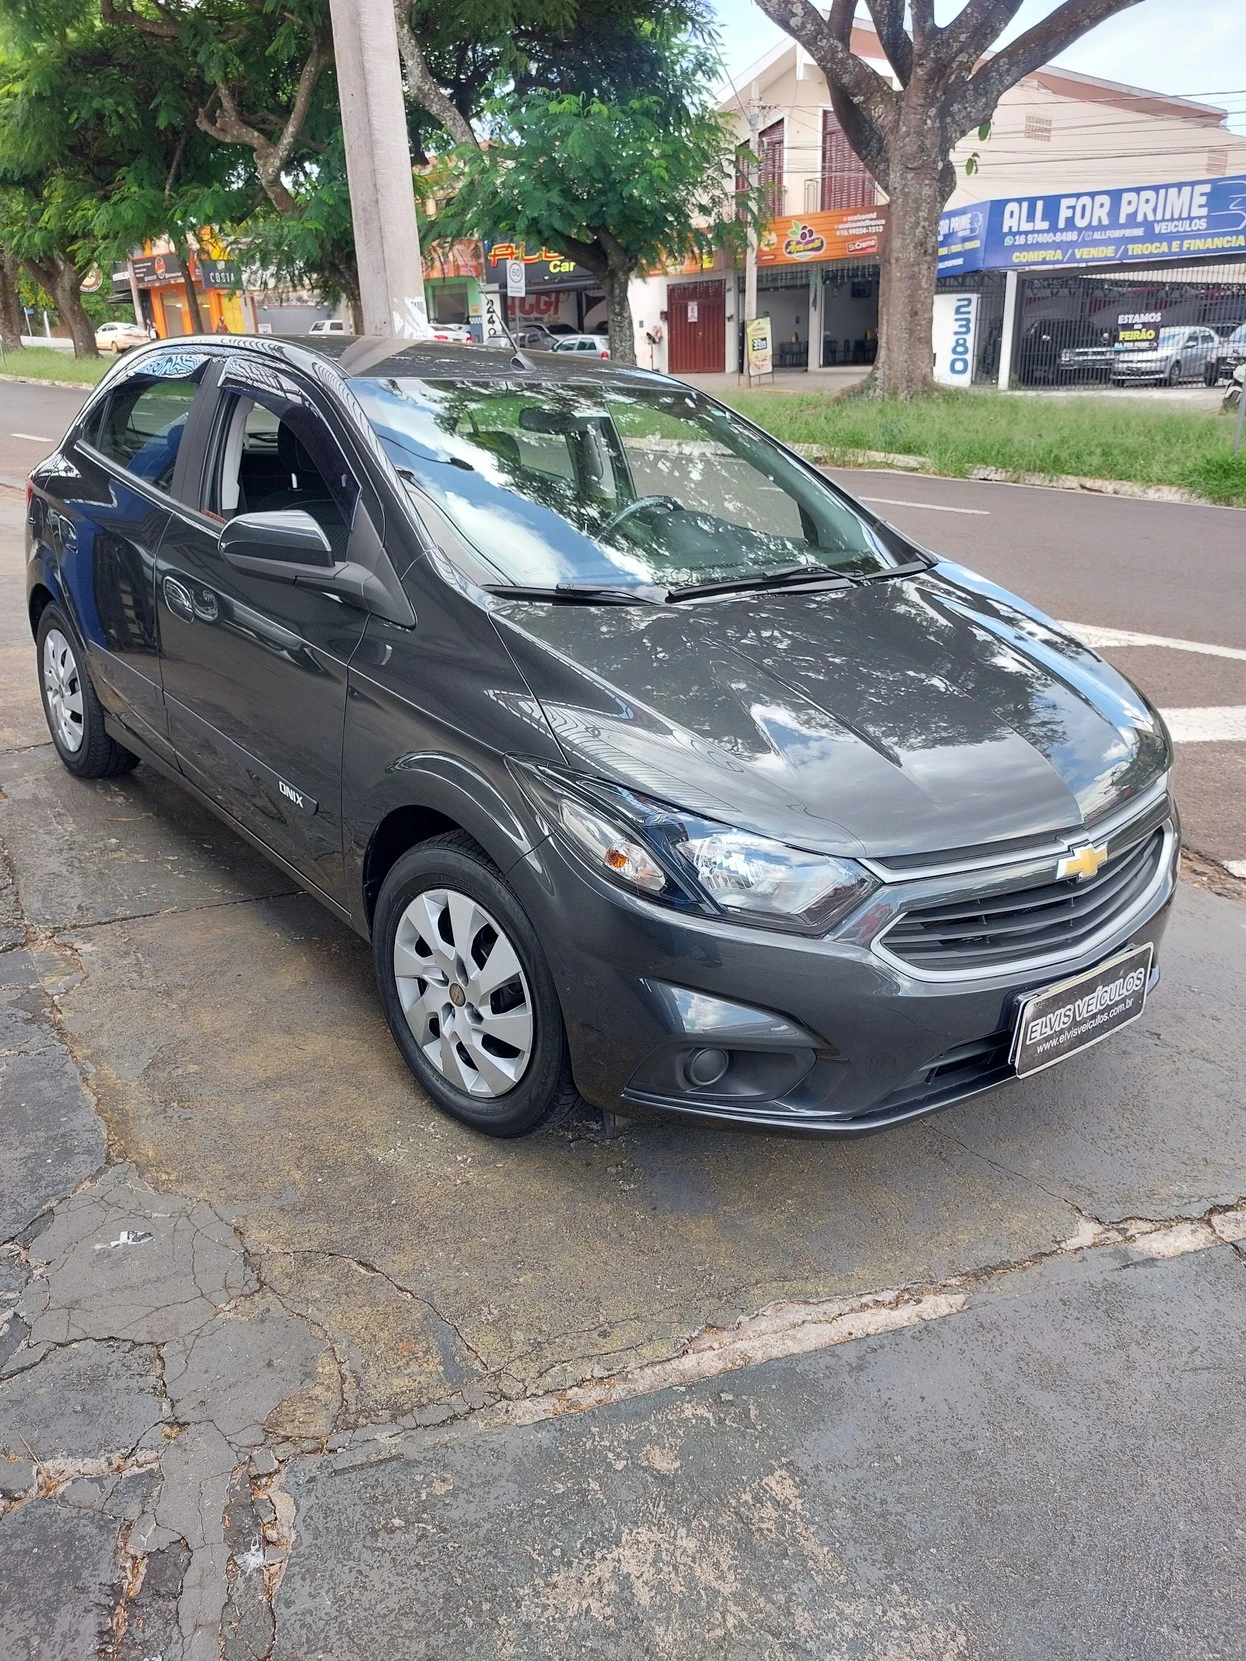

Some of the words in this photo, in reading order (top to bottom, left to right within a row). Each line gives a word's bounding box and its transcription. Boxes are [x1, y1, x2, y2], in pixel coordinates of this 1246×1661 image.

[1002, 200, 1049, 233] ALL
[1058, 195, 1111, 229] FOR
[1119, 184, 1212, 223] PRIME
[1154, 218, 1207, 234] VEICULOS
[1012, 249, 1063, 263] COMPRA
[1074, 245, 1116, 259] VENDE
[1127, 241, 1169, 256] TROCA
[1171, 240, 1180, 252] E
[1182, 235, 1246, 251] FINANCIA
[1014, 234, 1026, 245] 16
[209, 271, 235, 284] COSTA
[549, 260, 576, 273] Car
[1117, 312, 1161, 325] ESTAMOS
[949, 297, 973, 375] 2380
[1119, 328, 1156, 341] FEIRÃO
[279, 780, 304, 809] ONIX
[1026, 1004, 1074, 1045] ELVIS
[1074, 967, 1145, 1022] VEÍCULOS
[1036, 998, 1135, 1055] www.elvisveiculos.com.br
